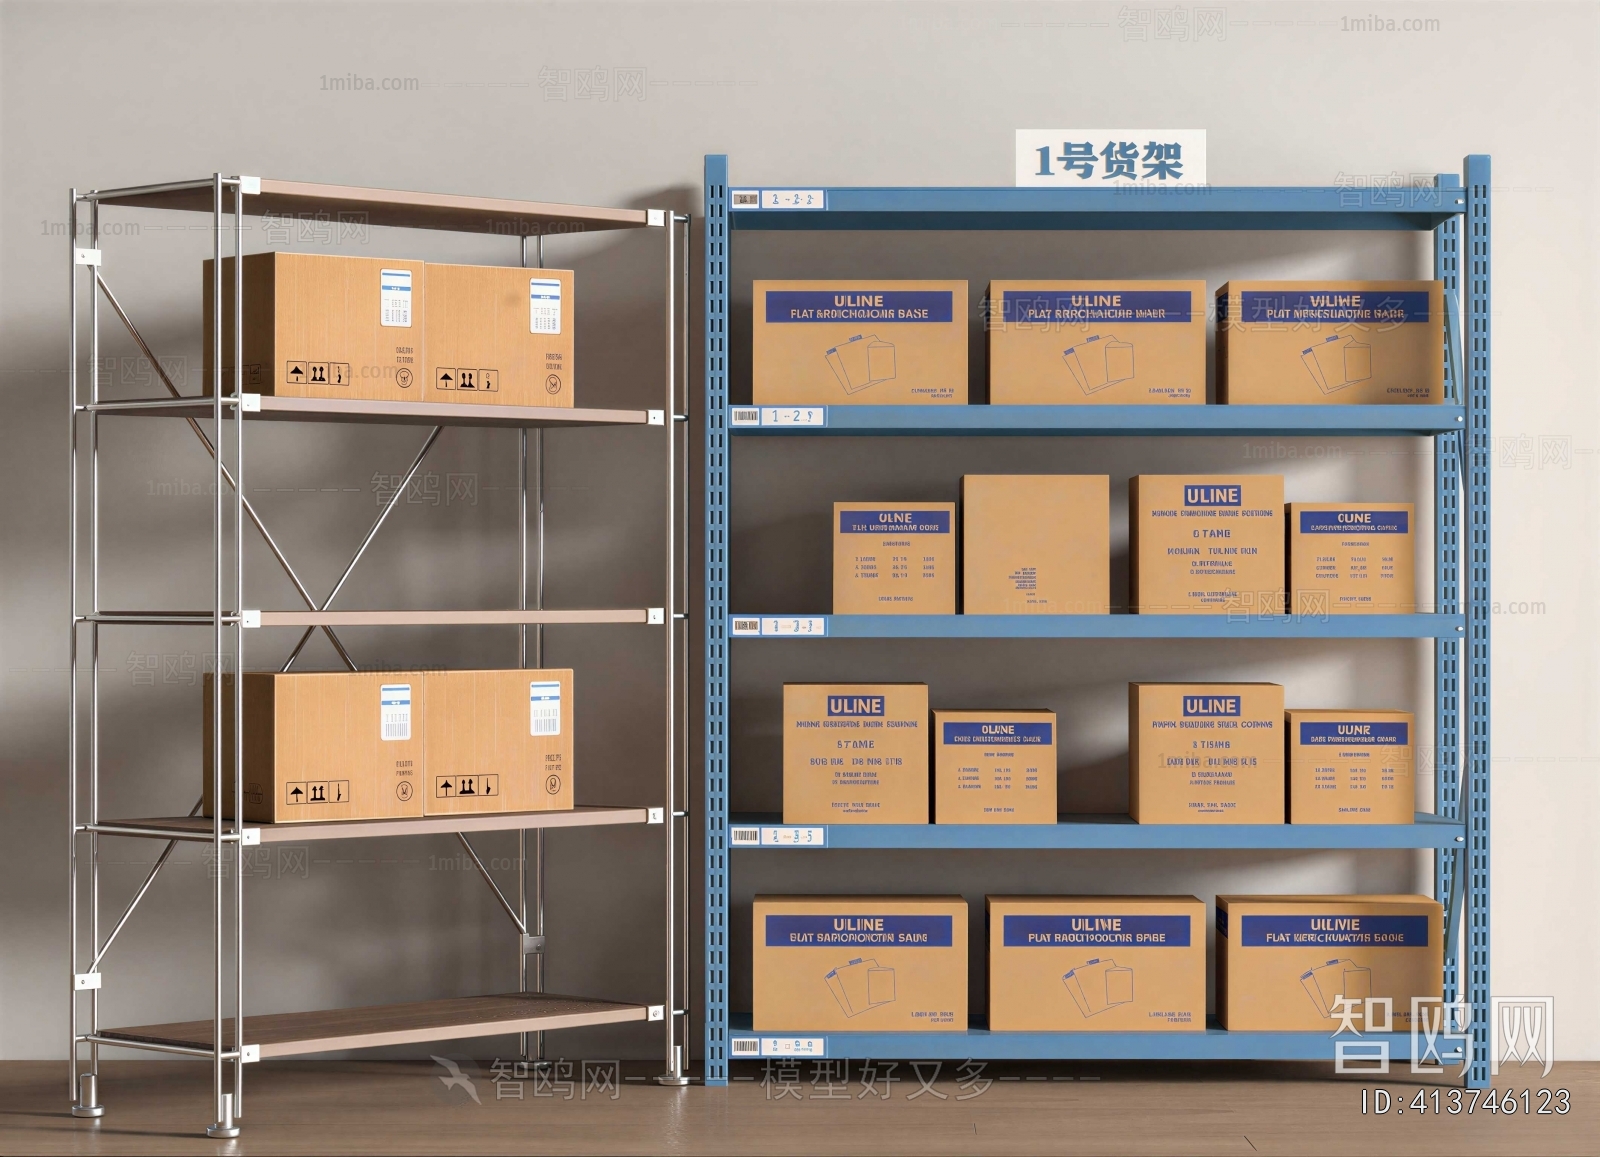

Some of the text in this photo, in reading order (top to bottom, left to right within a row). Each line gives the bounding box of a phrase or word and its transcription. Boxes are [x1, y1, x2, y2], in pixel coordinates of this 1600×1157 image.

[1035, 141, 1184, 180] 1号货架
[1071, 295, 1122, 307] ULINE
[791, 309, 813, 319] FLAT
[793, 410, 801, 422] 2
[1187, 488, 1239, 504] ULINE
[830, 698, 882, 714] ULINE
[1186, 698, 1237, 714] ULINE
